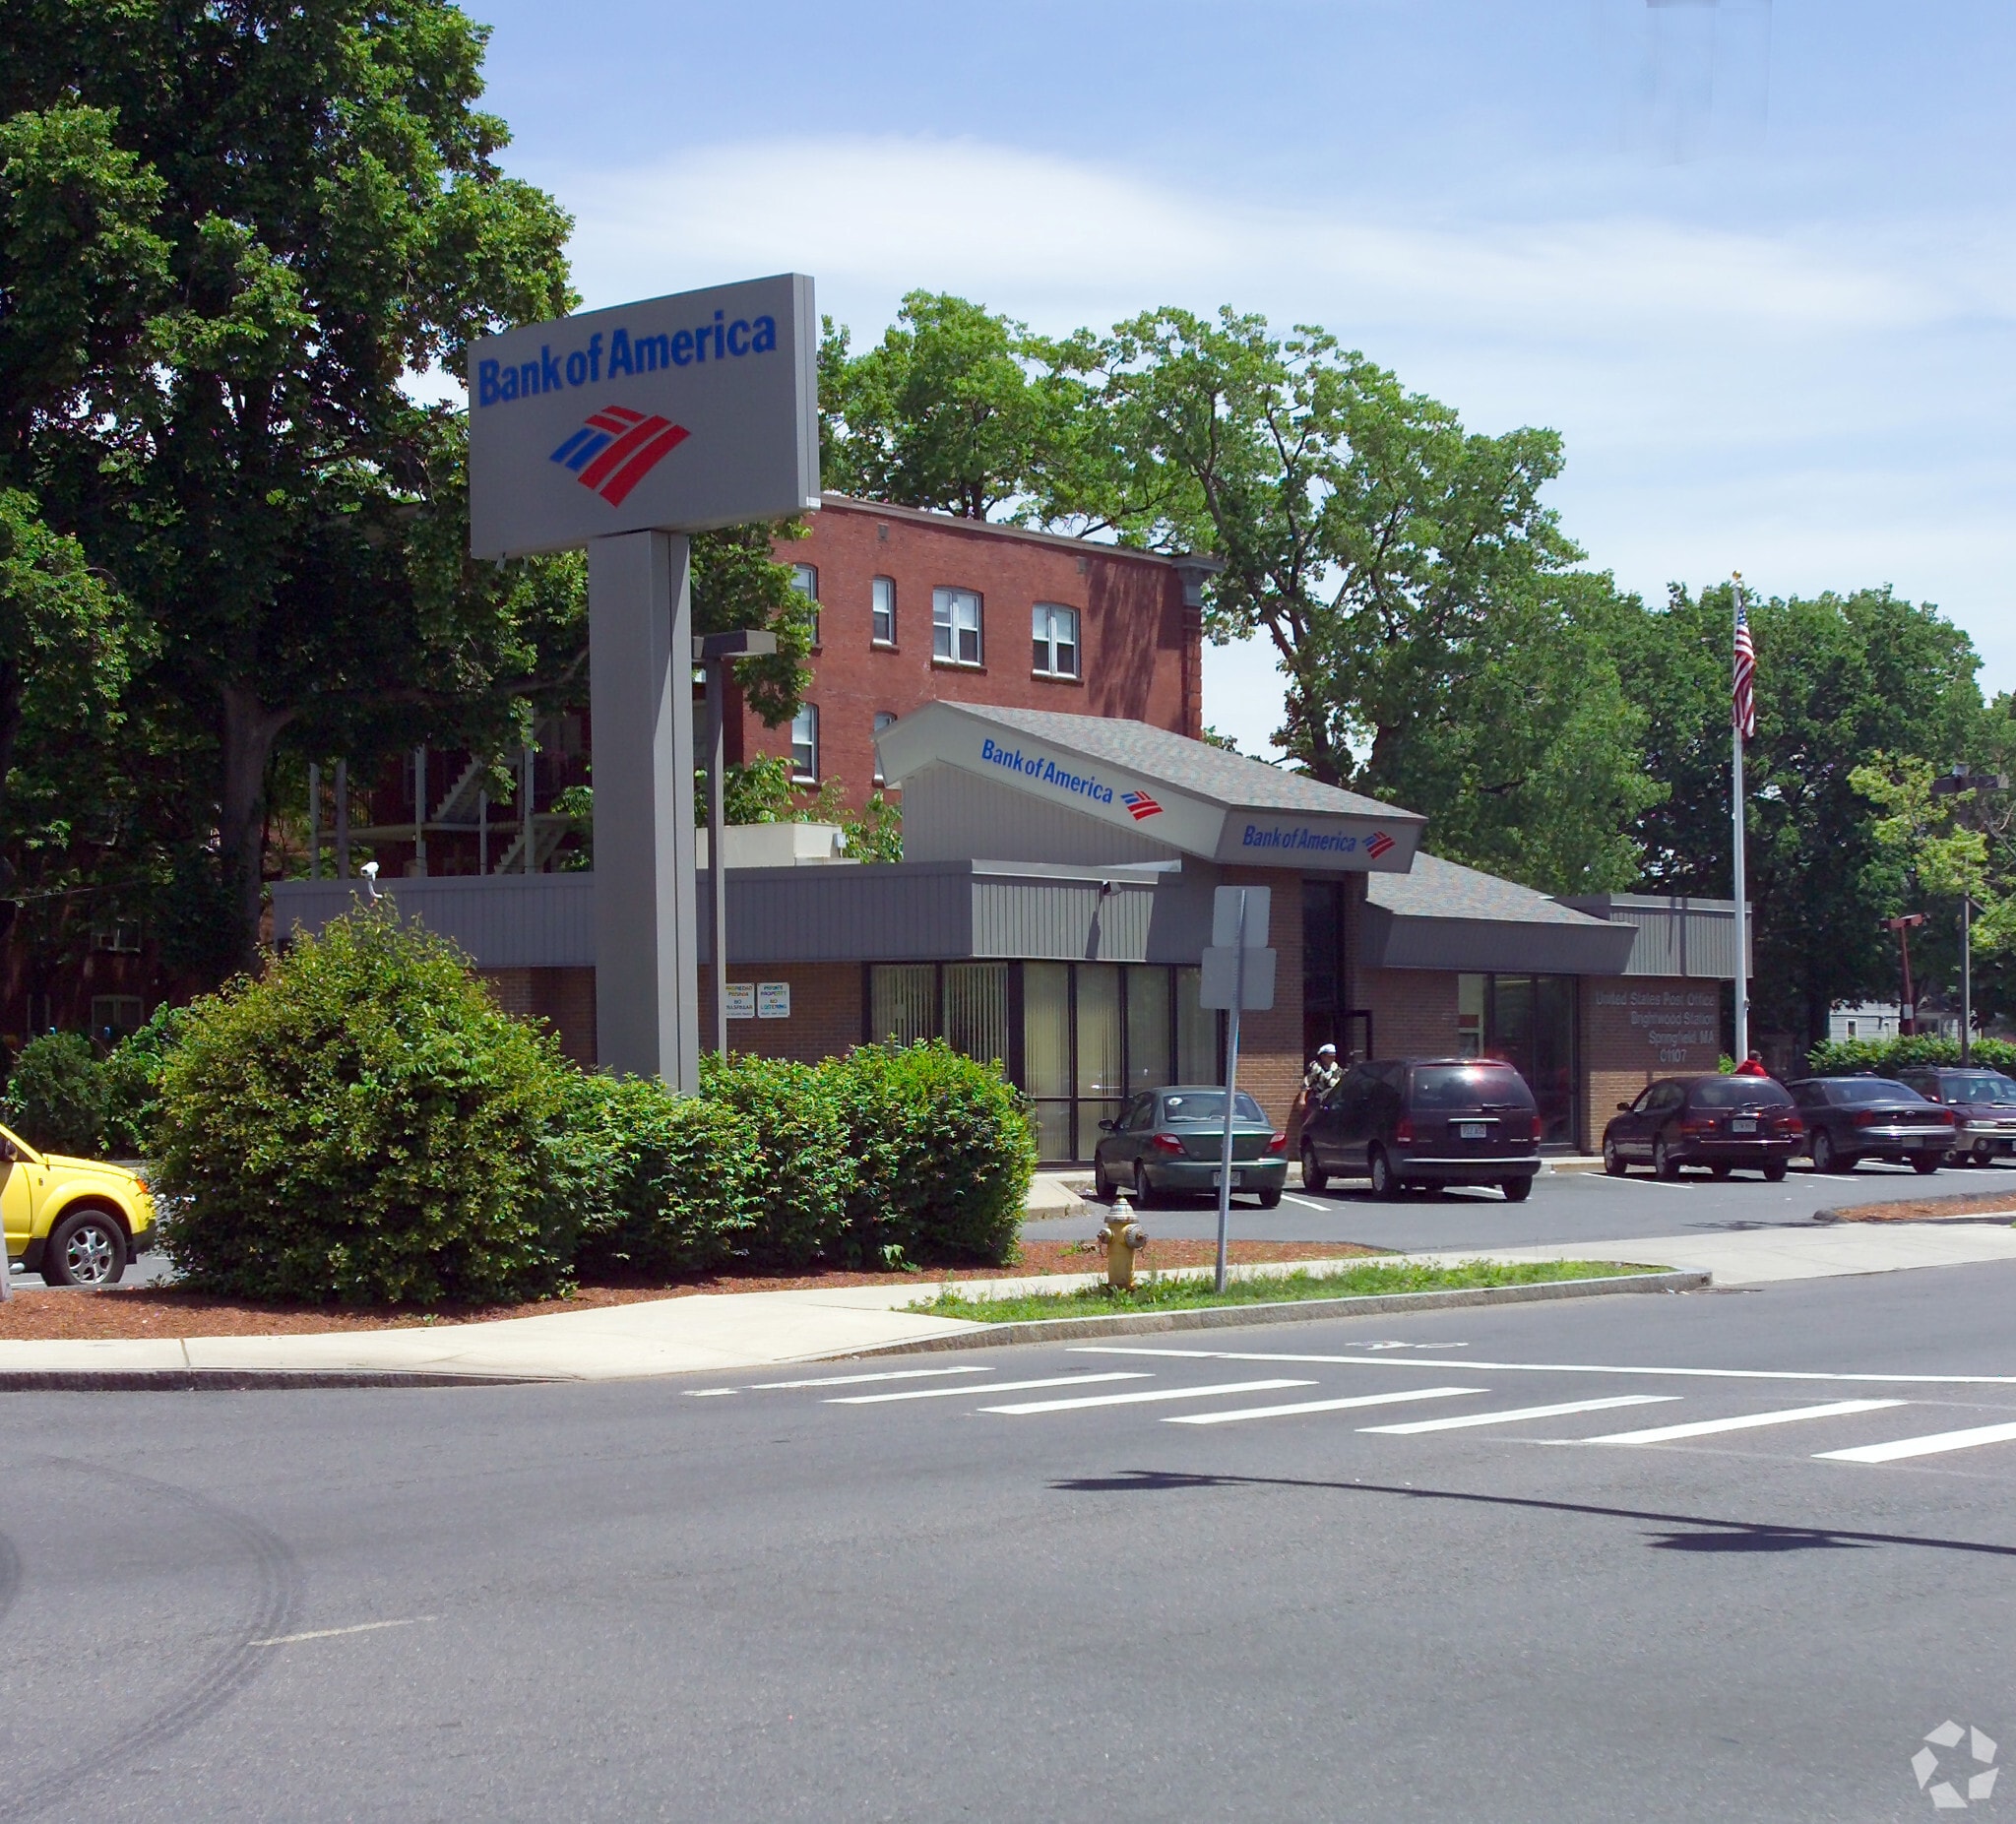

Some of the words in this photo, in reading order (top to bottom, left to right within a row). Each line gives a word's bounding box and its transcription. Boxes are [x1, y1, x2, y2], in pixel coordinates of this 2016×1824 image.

[478, 345, 563, 408] Bank
[566, 333, 602, 387] of
[607, 309, 777, 379] America
[981, 739, 1024, 772] Bank
[1025, 758, 1044, 778] of
[1042, 761, 1113, 804] America
[1242, 825, 1282, 848] Bank
[1283, 828, 1299, 849] of
[1297, 829, 1357, 852] America
[1596, 991, 1626, 1006] United
[1630, 992, 1661, 1006] States
[1663, 992, 1684, 1006] Post
[1687, 992, 1715, 1006] Office
[1683, 1012, 1715, 1026] Station
[1700, 1031, 1715, 1044] MA
[1660, 1048, 1687, 1062] 01107
